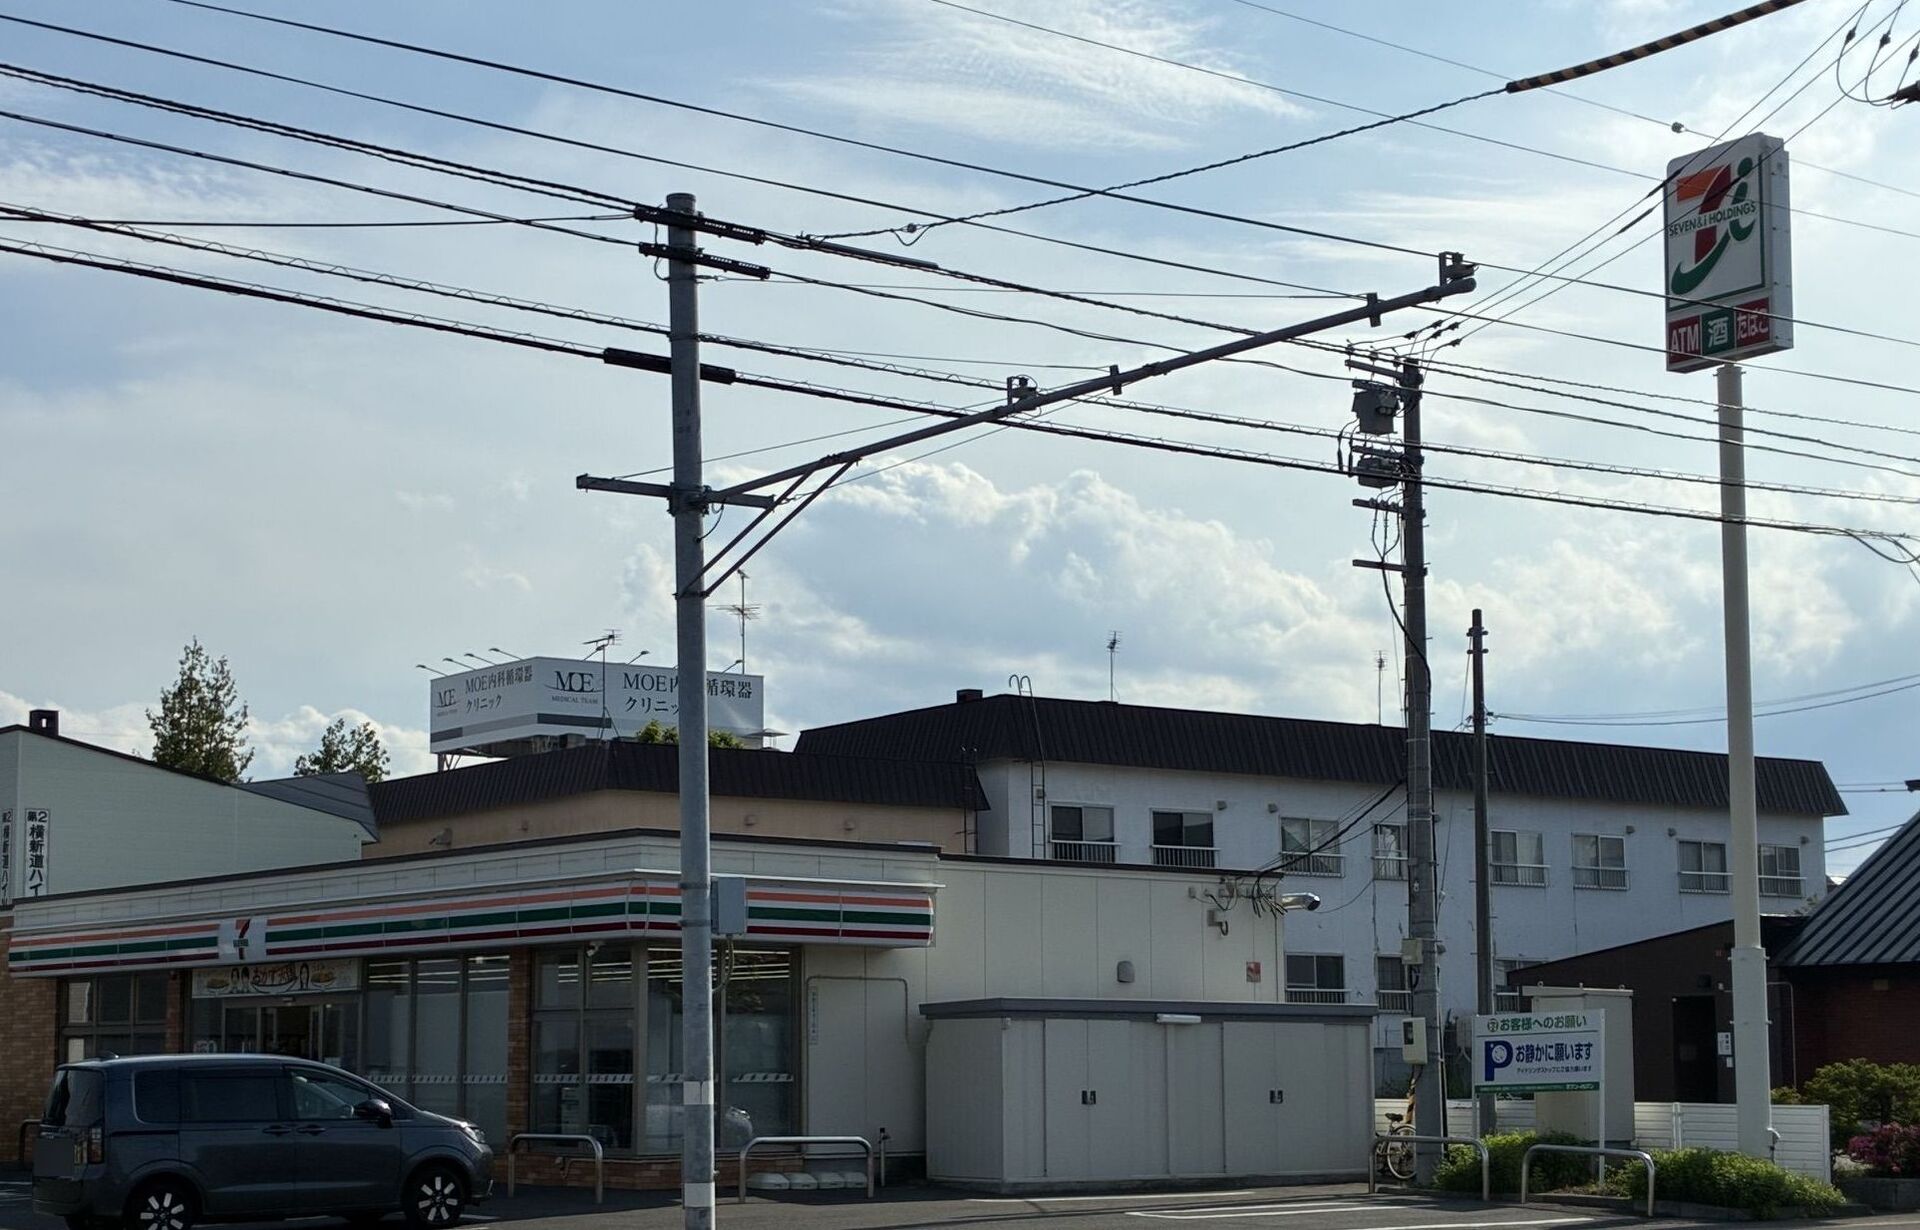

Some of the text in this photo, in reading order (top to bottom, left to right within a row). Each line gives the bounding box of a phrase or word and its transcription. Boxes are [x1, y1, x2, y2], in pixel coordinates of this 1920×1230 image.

[1709, 200, 1757, 225] HOLDINGS
[1707, 315, 1729, 348] 酒
[1736, 307, 1769, 341] たばこ
[1671, 323, 1699, 354] ATM
[466, 694, 502, 713] クリニック
[626, 695, 680, 714] クリニッ
[1515, 1042, 1593, 1063] お静かに願います
